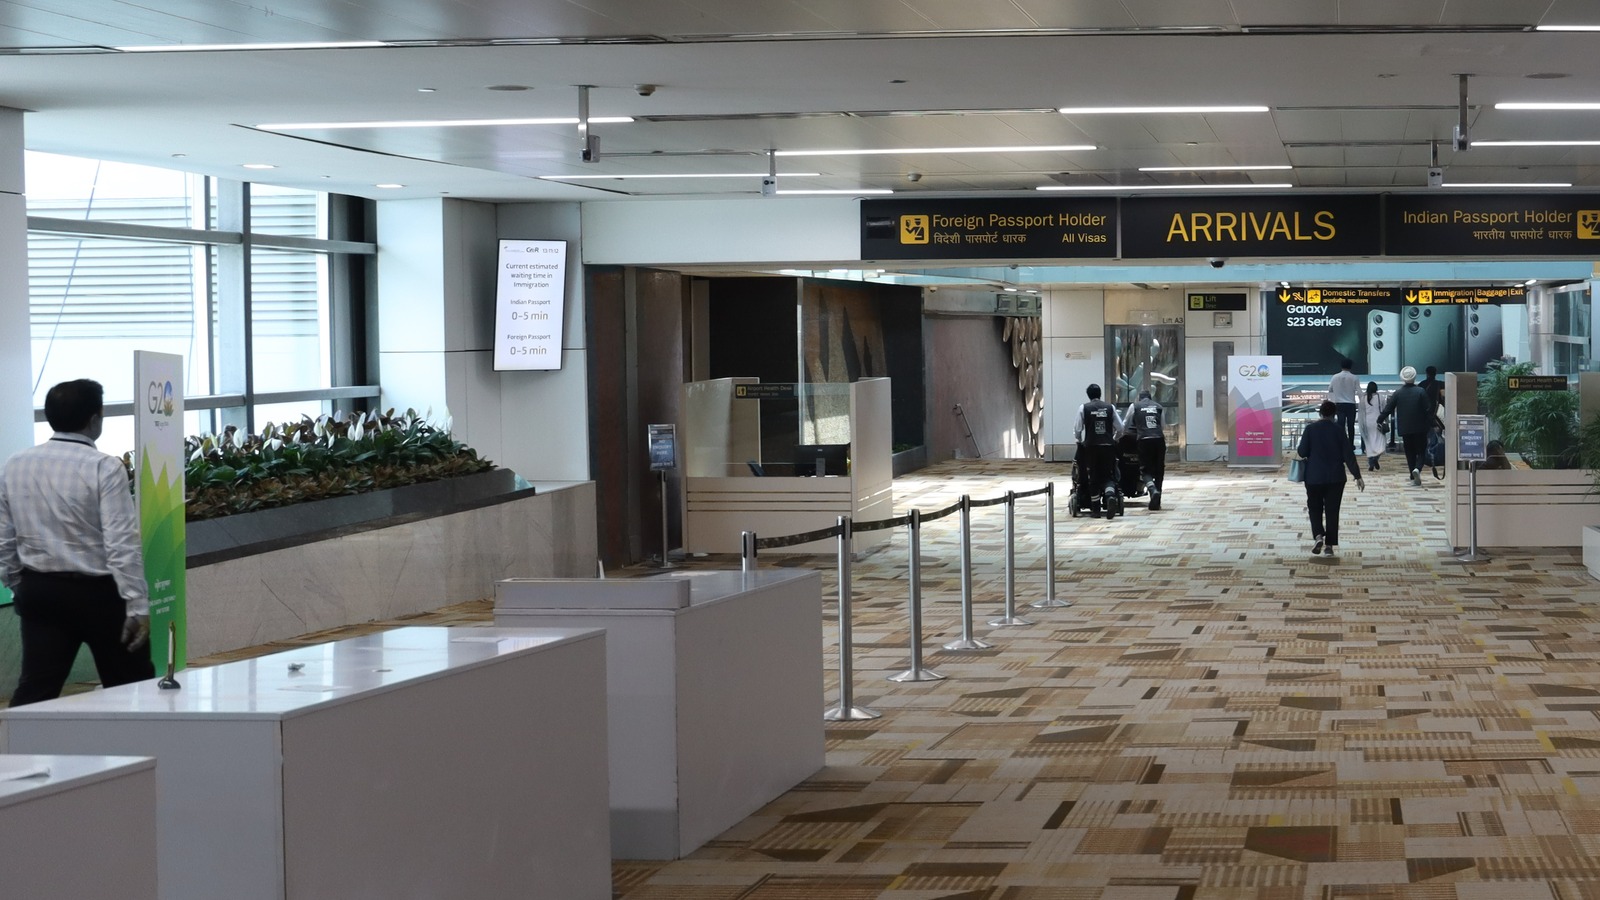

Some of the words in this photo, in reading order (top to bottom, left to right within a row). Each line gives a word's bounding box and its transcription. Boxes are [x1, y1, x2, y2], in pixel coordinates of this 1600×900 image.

[933, 214, 984, 230] Foreign
[989, 213, 1054, 229] Passport
[1059, 212, 1106, 226] Holder
[1404, 210, 1448, 224] Indian
[1453, 210, 1519, 226] Passport
[1524, 210, 1572, 223] Holder
[1166, 211, 1336, 242] ARRIVALS
[934, 232, 961, 244] विदेशी
[965, 231, 998, 244] पासपोर्ट
[1002, 234, 1027, 243] धारक
[1061, 233, 1075, 243] All
[1077, 233, 1107, 243] Visas
[1473, 228, 1505, 240] भारतीय
[1510, 227, 1543, 240] पासपोर्ट
[1548, 230, 1572, 240] धारक
[511, 272, 532, 281] waiting
[513, 281, 550, 290] Immigration
[1358, 289, 1391, 298] Transfers
[1434, 289, 1474, 298] Immigration
[1477, 288, 1507, 298] Baggage
[1510, 288, 1524, 296] Exit
[528, 299, 551, 307] Passport
[1205, 295, 1217, 303] Lift
[530, 310, 549, 321] min
[1286, 304, 1328, 316] Galaxy
[1286, 317, 1306, 327] S23
[1307, 316, 1342, 327] Series
[507, 334, 527, 342] Foreign
[528, 334, 551, 342] Passport
[528, 345, 548, 356] min
